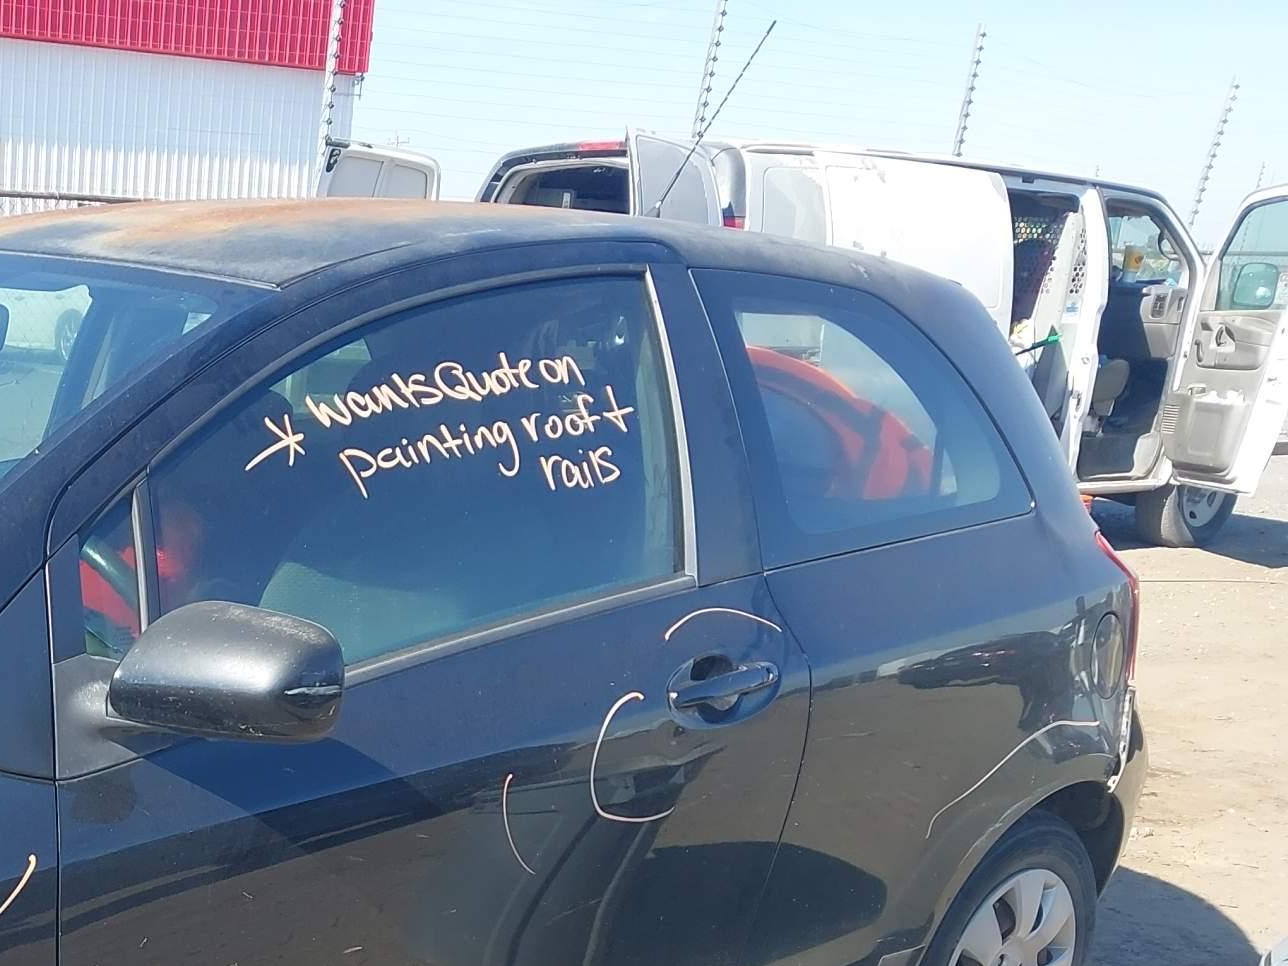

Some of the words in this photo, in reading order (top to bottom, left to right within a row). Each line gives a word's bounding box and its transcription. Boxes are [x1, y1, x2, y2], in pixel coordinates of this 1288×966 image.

[538, 356, 585, 386] on
[339, 420, 521, 499] painting
[520, 394, 601, 442] roof
